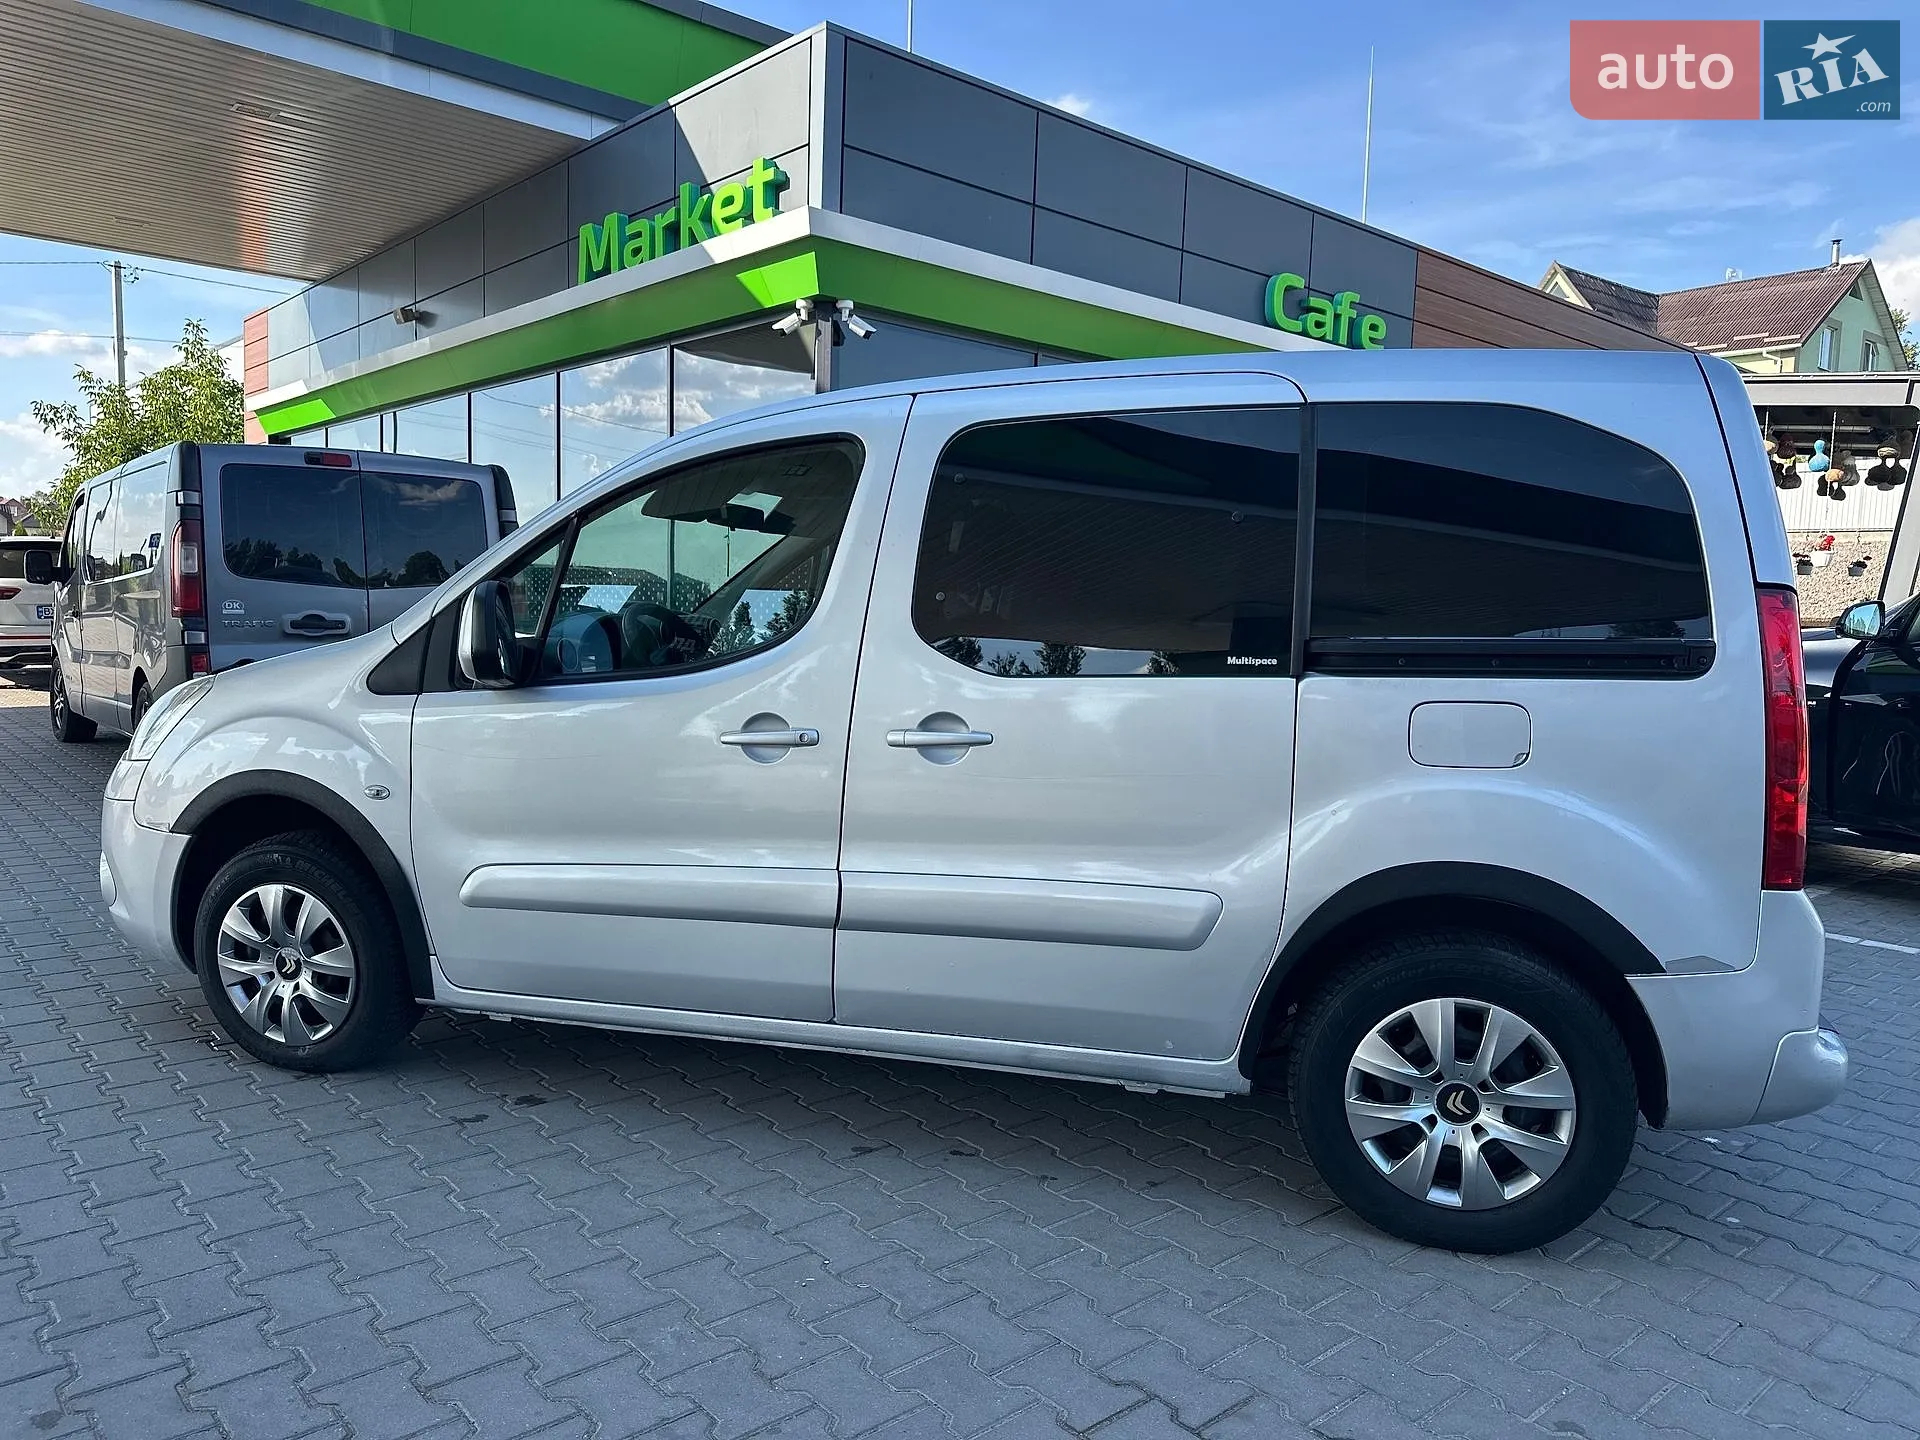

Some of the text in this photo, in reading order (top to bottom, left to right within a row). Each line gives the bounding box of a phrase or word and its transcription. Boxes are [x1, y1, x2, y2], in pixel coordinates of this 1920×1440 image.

[577, 157, 788, 285] Market
[1265, 272, 1387, 350] Cafe
[222, 620, 275, 628] TRAFIC
[1227, 656, 1278, 666] Multispace
